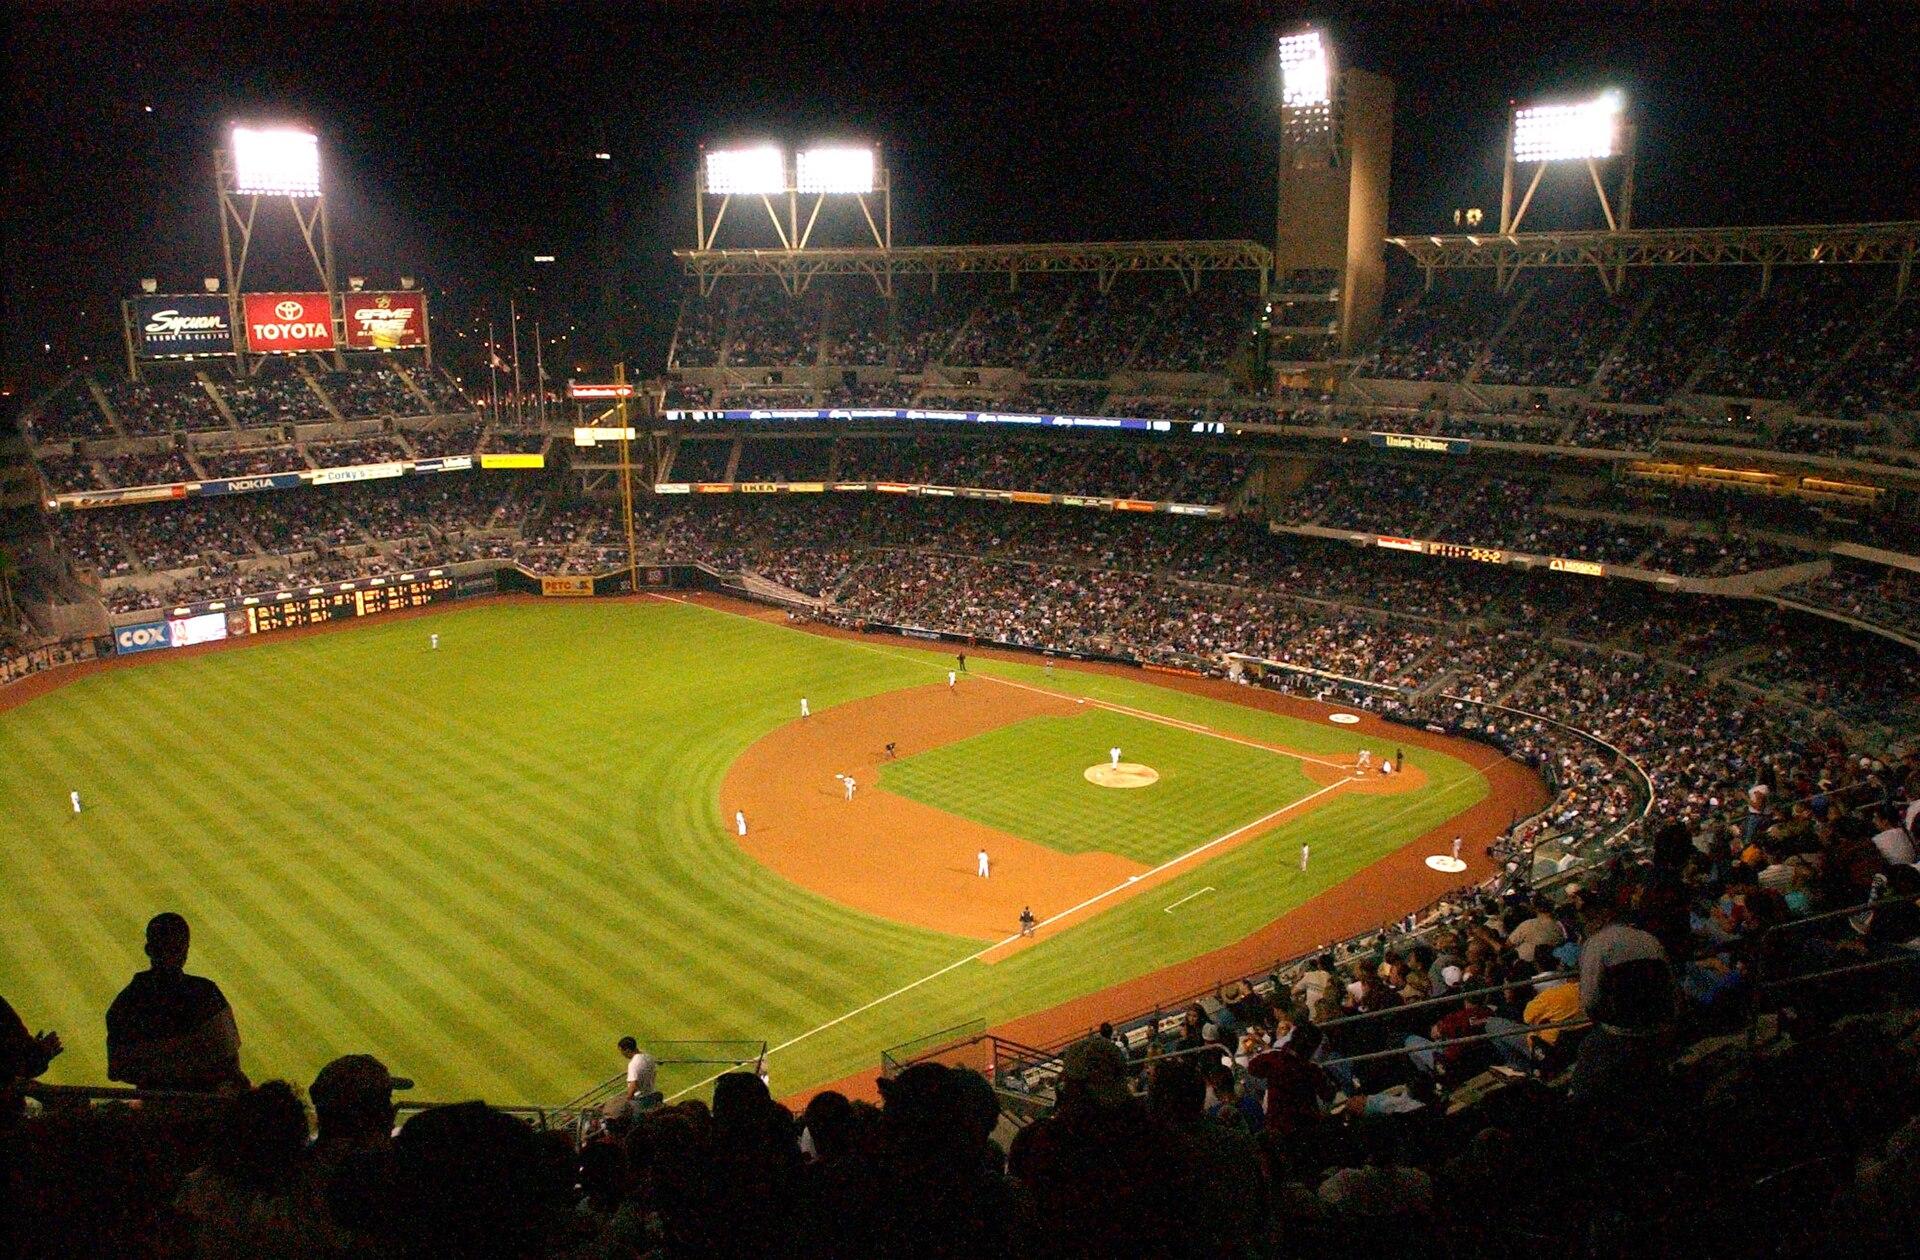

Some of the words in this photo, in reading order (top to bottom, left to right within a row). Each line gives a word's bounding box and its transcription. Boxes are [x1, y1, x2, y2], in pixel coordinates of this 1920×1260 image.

[145, 309, 228, 336] Sycuan
[354, 308, 415, 320] GAME
[253, 322, 328, 340] TOYOTA
[228, 478, 276, 491] NOKIA
[119, 627, 166, 647] COX
